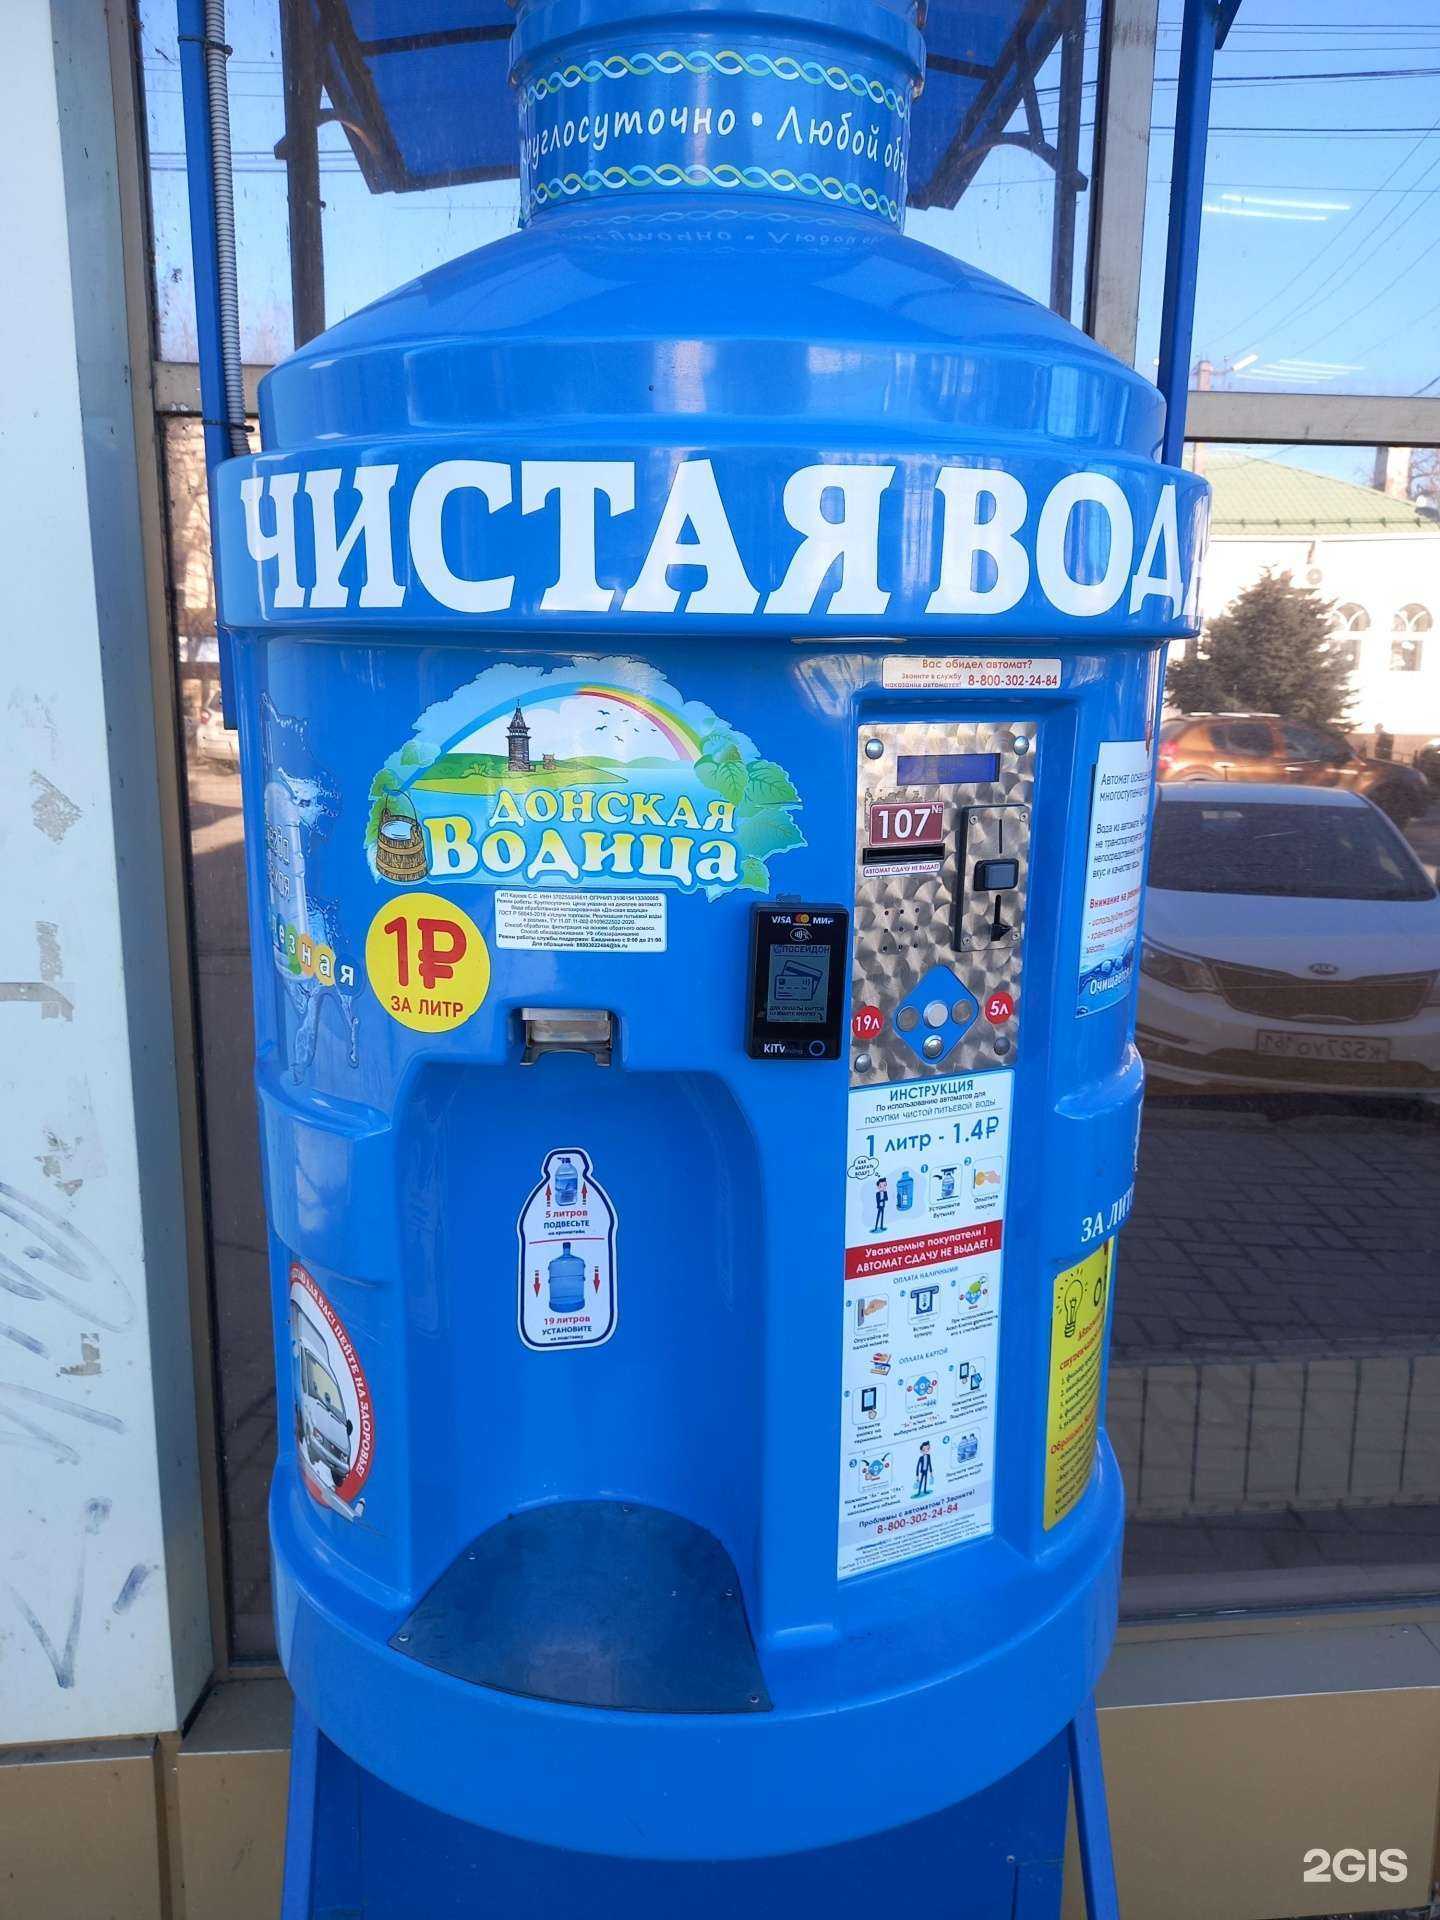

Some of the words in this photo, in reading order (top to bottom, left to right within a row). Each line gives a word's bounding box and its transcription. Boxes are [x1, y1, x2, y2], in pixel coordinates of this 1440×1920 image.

[777, 105, 880, 163] Любой
[240, 458, 896, 616] ЧИСТАЯ
[922, 659, 942, 669] Вас
[946, 659, 983, 672] обидел
[986, 660, 1033, 670] автомат?
[936, 673, 962, 682] службу
[967, 674, 1058, 687] 8-800-302-24-84
[488, 788, 737, 834] ДОНСКАЯ
[877, 807, 931, 839] 107
[771, 915, 792, 925] VISA
[812, 916, 834, 925] МИР
[390, 995, 412, 1014] ЗА
[418, 999, 465, 1018] ЛИТР
[989, 1000, 1009, 1016] 5л
[855, 1015, 880, 1032] 19л
[890, 1079, 975, 1102] ИНСТРУКЦИЯ
[876, 1103, 886, 1112] По
[939, 1092, 973, 1104] автоматов
[973, 1090, 987, 1101] для
[864, 1113, 901, 1125] ПОКУПКИ
[902, 1105, 934, 1119] ЧИСТОЙ
[934, 1100, 973, 1115] ПИТЬЕВОЙ
[975, 1098, 997, 1109] ВОДЫ
[866, 1134, 875, 1157] 1
[884, 1132, 932, 1153] литр
[545, 1210, 551, 1219] 5
[553, 1210, 588, 1218] литров
[543, 1219, 590, 1230] ПОДВЕСЬТЕ
[1081, 1211, 1105, 1243] ЗА
[865, 1240, 926, 1258] Уважаемые
[927, 1230, 982, 1248] покупатели
[856, 1256, 903, 1274] АВТОМАТ
[904, 1249, 939, 1266] СДАЧУ
[940, 1247, 952, 1258] НЕ
[953, 1239, 989, 1255] ВЫДАЕТ
[893, 1273, 919, 1285] ОПЛАТА
[542, 1325, 592, 1335] УСТАНОВИТЕ
[544, 1317, 555, 1326] 19
[557, 1316, 591, 1324] литров
[334, 1325, 360, 1375] ПЕЙТЕ
[355, 1376, 367, 1399] НА
[858, 1513, 898, 1529] Проблемы
